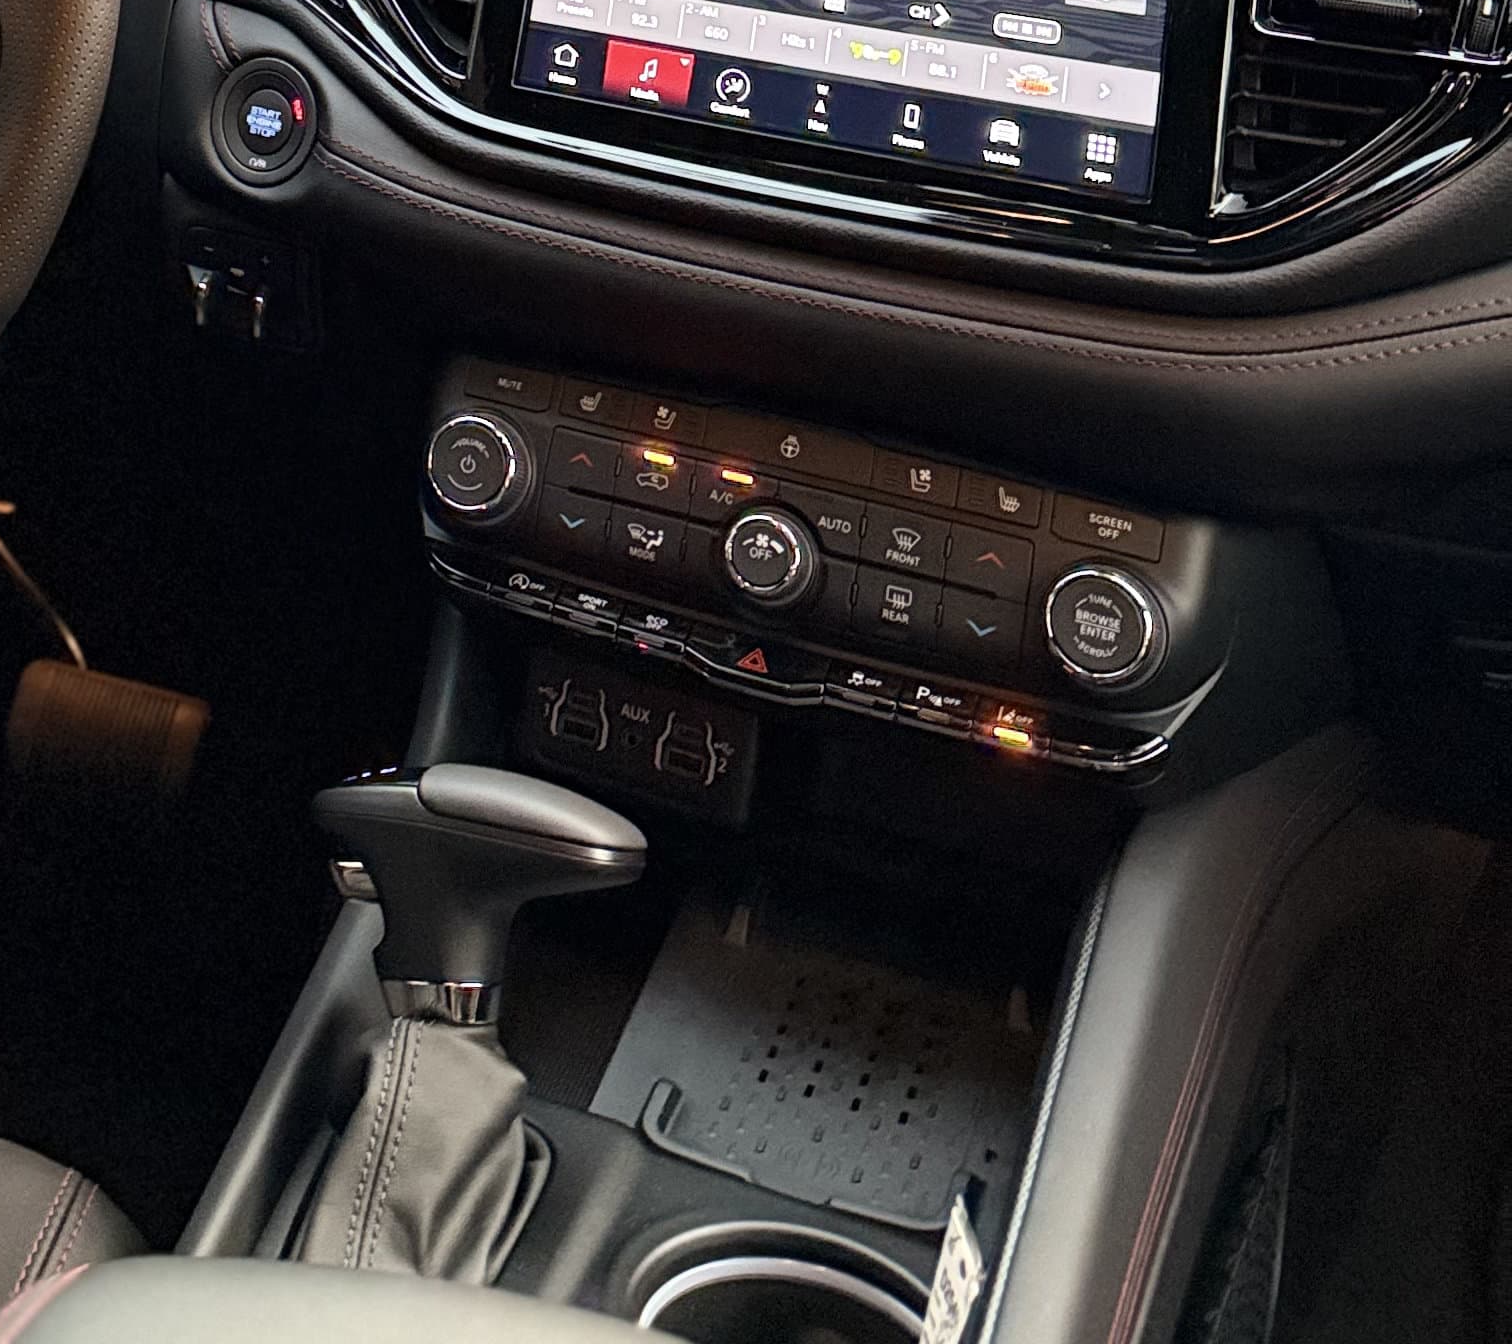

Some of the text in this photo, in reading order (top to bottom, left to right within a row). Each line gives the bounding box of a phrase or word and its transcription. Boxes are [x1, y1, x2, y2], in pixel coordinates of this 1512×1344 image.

[548, 71, 577, 86] Home
[629, 87, 660, 103] Media
[250, 105, 282, 121] START
[709, 101, 751, 120] Comfort
[249, 125, 276, 138] STOP
[807, 118, 829, 133] Nav
[891, 132, 926, 151] Phone
[982, 149, 1022, 168] Vehicle
[1084, 167, 1114, 185] Apps
[497, 377, 523, 391] MUTE
[457, 437, 487, 453] VOLUME
[709, 489, 734, 505] A/C
[817, 515, 853, 533] AUTO
[1088, 513, 1133, 532] SCREEN
[1097, 527, 1120, 540] OFF
[629, 546, 656, 561] MODE
[749, 546, 773, 561] OFF
[885, 549, 921, 567] FRONT
[529, 581, 546, 591] OFF
[578, 593, 609, 608] SPORT
[1088, 592, 1113, 609] TUNE
[881, 611, 910, 625] REAR
[1075, 608, 1121, 629] BROWSE
[1079, 624, 1117, 642] ENTER
[1076, 640, 1115, 658] SCROLL
[864, 678, 883, 688] OFF
[916, 686, 931, 700] P
[943, 697, 962, 707] OFF
[620, 702, 652, 724] AUX
[1015, 714, 1034, 725] OFF
[716, 758, 728, 773] 2
